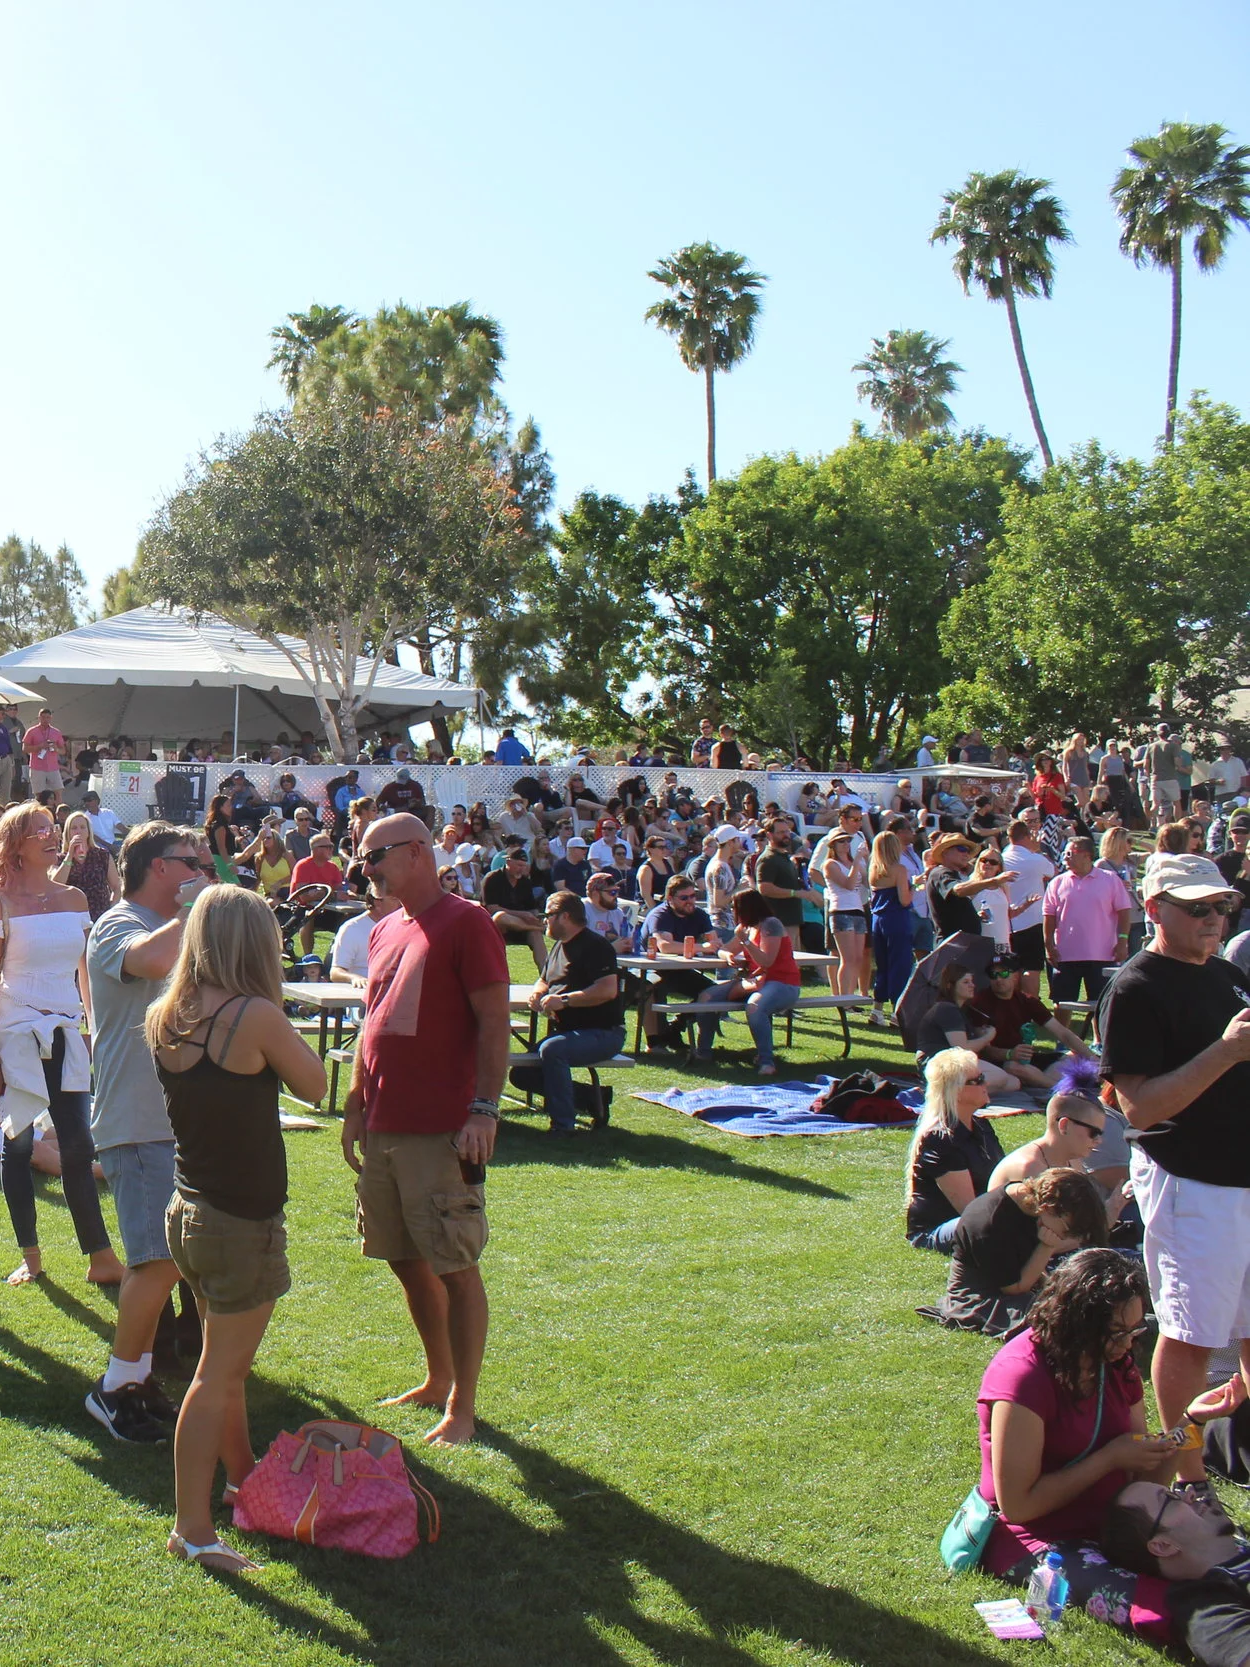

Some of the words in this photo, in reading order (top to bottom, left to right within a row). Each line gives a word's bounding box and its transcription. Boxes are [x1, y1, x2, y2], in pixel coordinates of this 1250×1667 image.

[168, 765, 192, 773] MUST
[193, 766, 205, 774] BE
[128, 775, 140, 793] 21
[189, 776, 200, 800] 1
